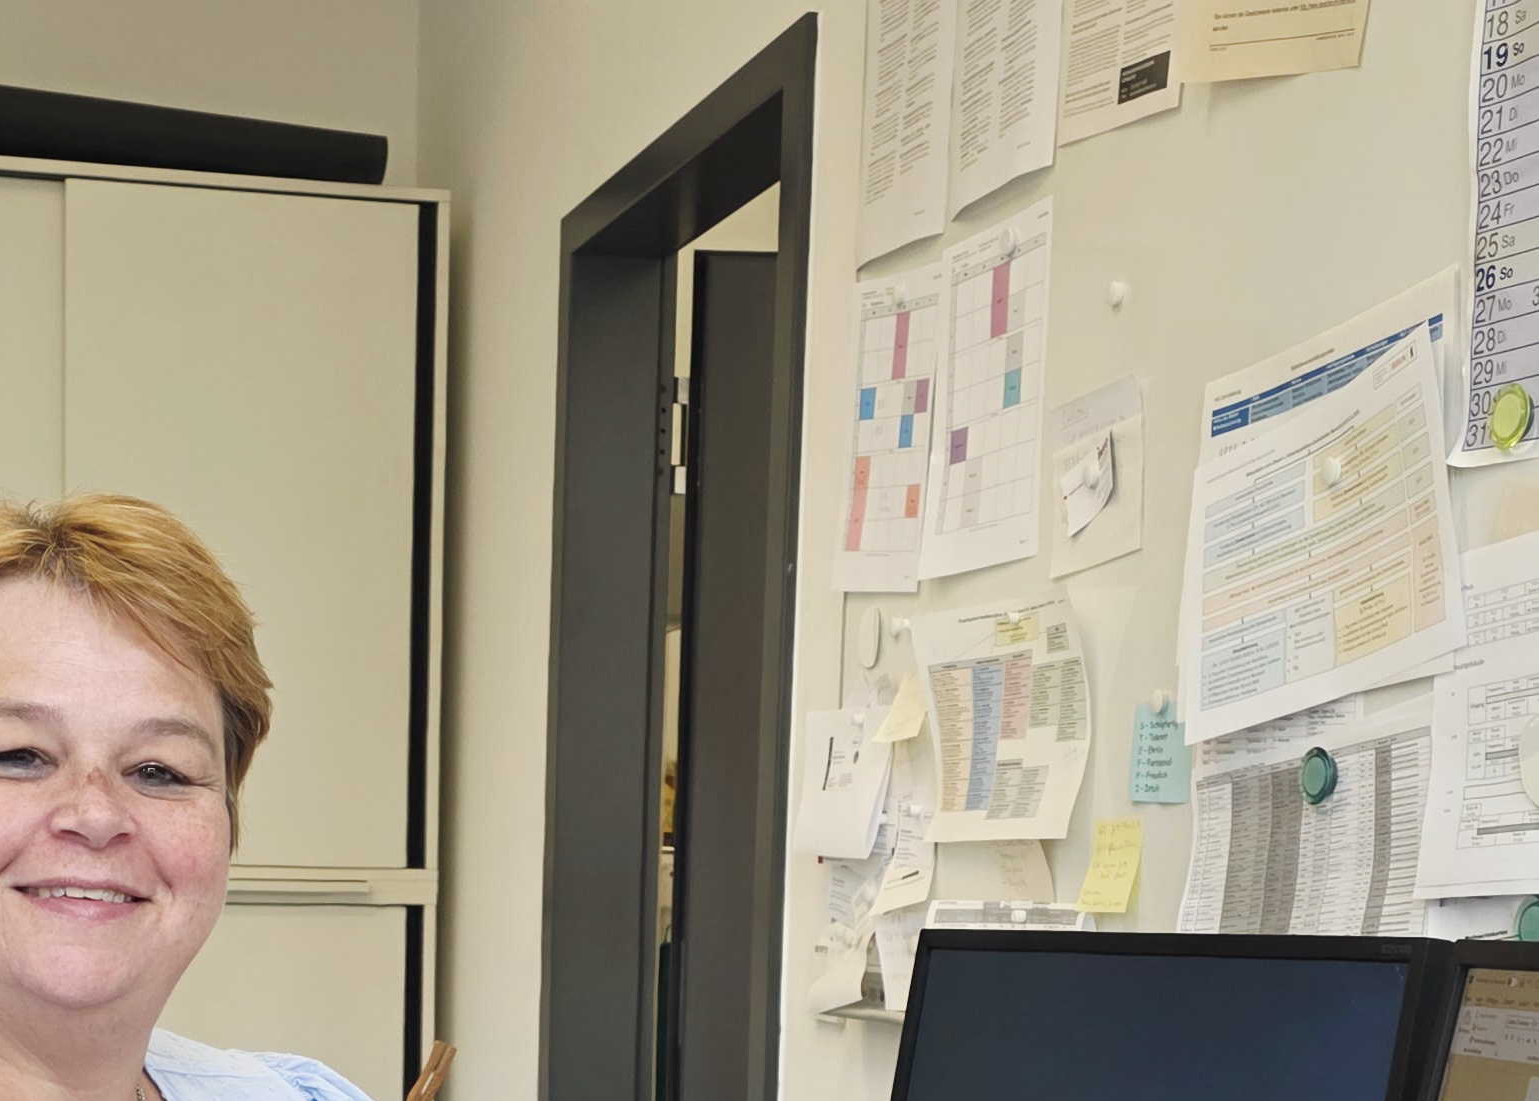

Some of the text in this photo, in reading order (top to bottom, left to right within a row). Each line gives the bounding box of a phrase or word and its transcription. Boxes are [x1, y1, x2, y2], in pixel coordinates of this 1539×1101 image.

[1487, 9, 1527, 38] 18 Sa
[1484, 42, 1525, 70] 19 So
[1482, 73, 1526, 103] 20 Mo
[1481, 105, 1519, 135] 21 Di
[1479, 138, 1503, 167] 22
[1481, 169, 1519, 198] 23 Do
[1479, 200, 1515, 230] 24 Fr
[1476, 232, 1516, 261] 25 Sa
[1476, 265, 1513, 292] 26 So
[1475, 295, 1512, 324] 27 Mo
[1474, 327, 1496, 355] 28
[1473, 359, 1494, 386] 29
[1471, 390, 1492, 417] 30
[1466, 421, 1486, 448] 31
